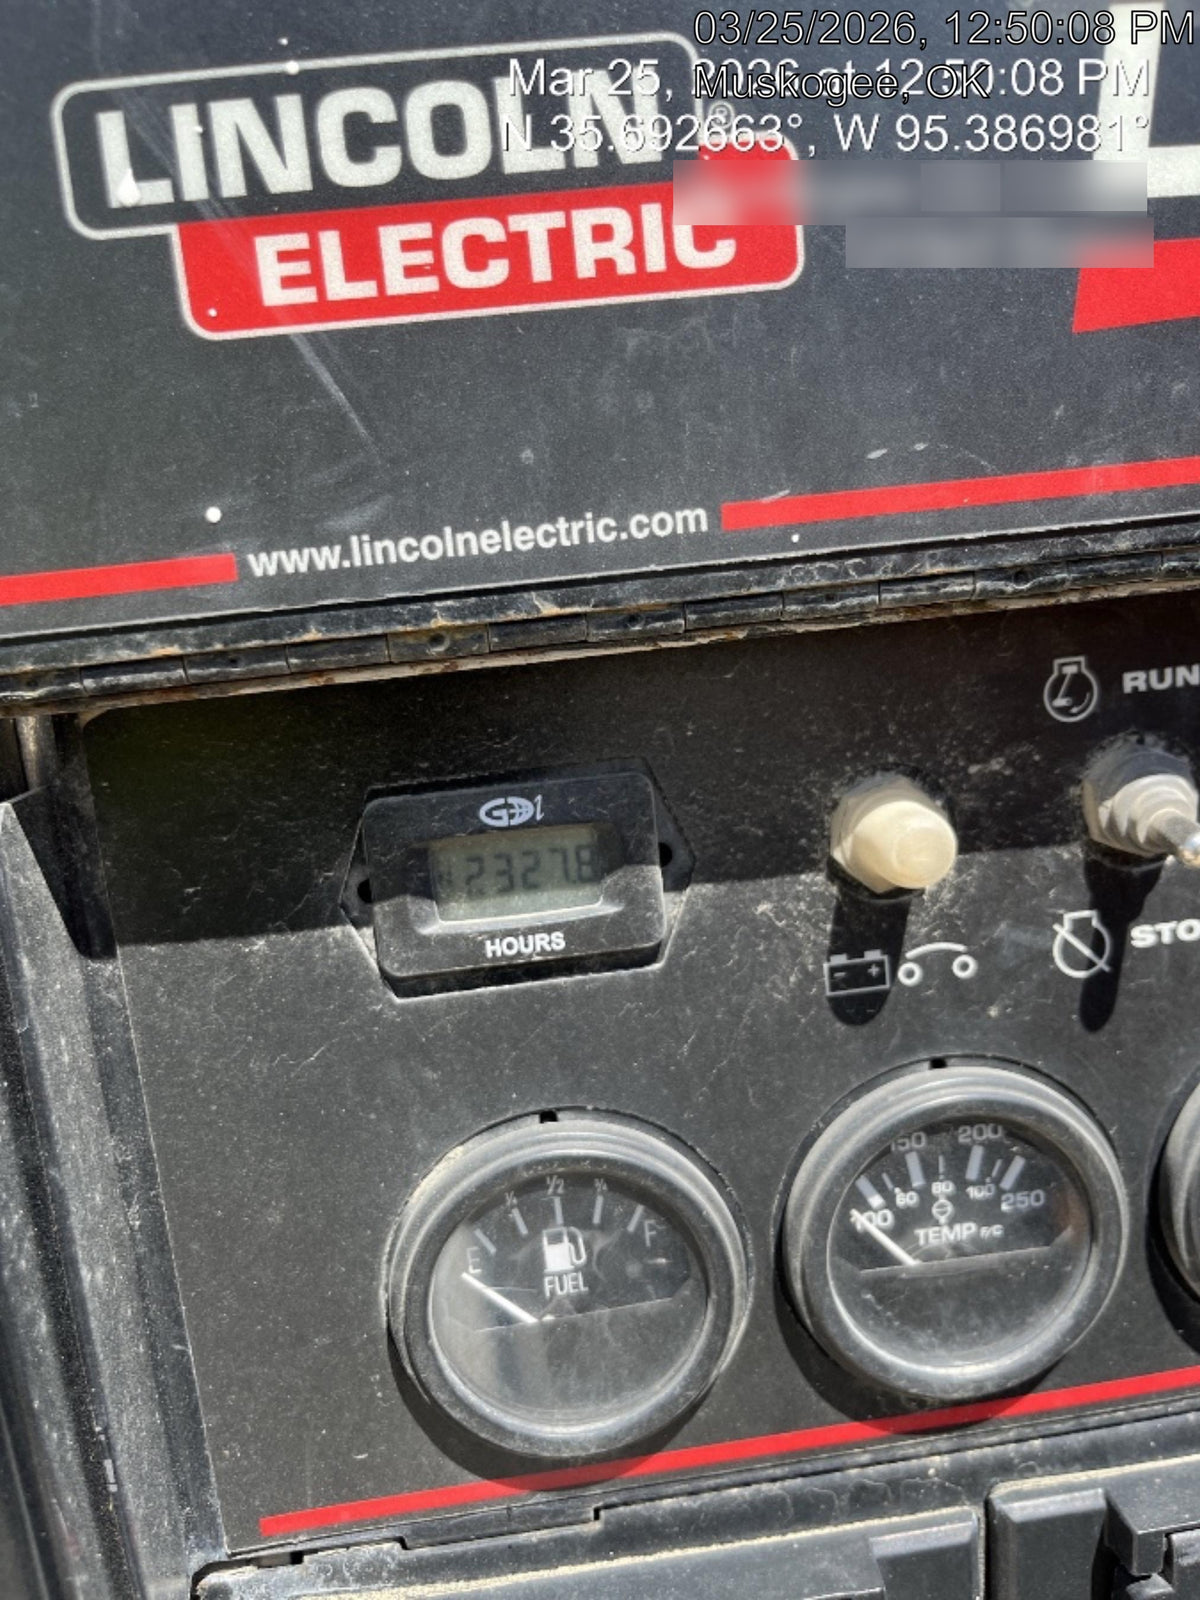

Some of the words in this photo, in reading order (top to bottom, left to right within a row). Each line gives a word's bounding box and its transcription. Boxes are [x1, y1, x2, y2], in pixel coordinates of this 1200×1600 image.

[95, 66, 663, 209] LINCOLN
[252, 200, 737, 307] ELECTRIC
[247, 507, 708, 578] www.lincolnelectric.com
[1122, 662, 1200, 695] RUN
[485, 931, 567, 959] HOURS
[957, 1123, 1003, 1144] 200
[1001, 1189, 1046, 1213] 250
[643, 1219, 660, 1247] F
[913, 1221, 978, 1246] TEMP
[465, 1246, 483, 1275] E
[543, 1271, 590, 1298] FUEL
